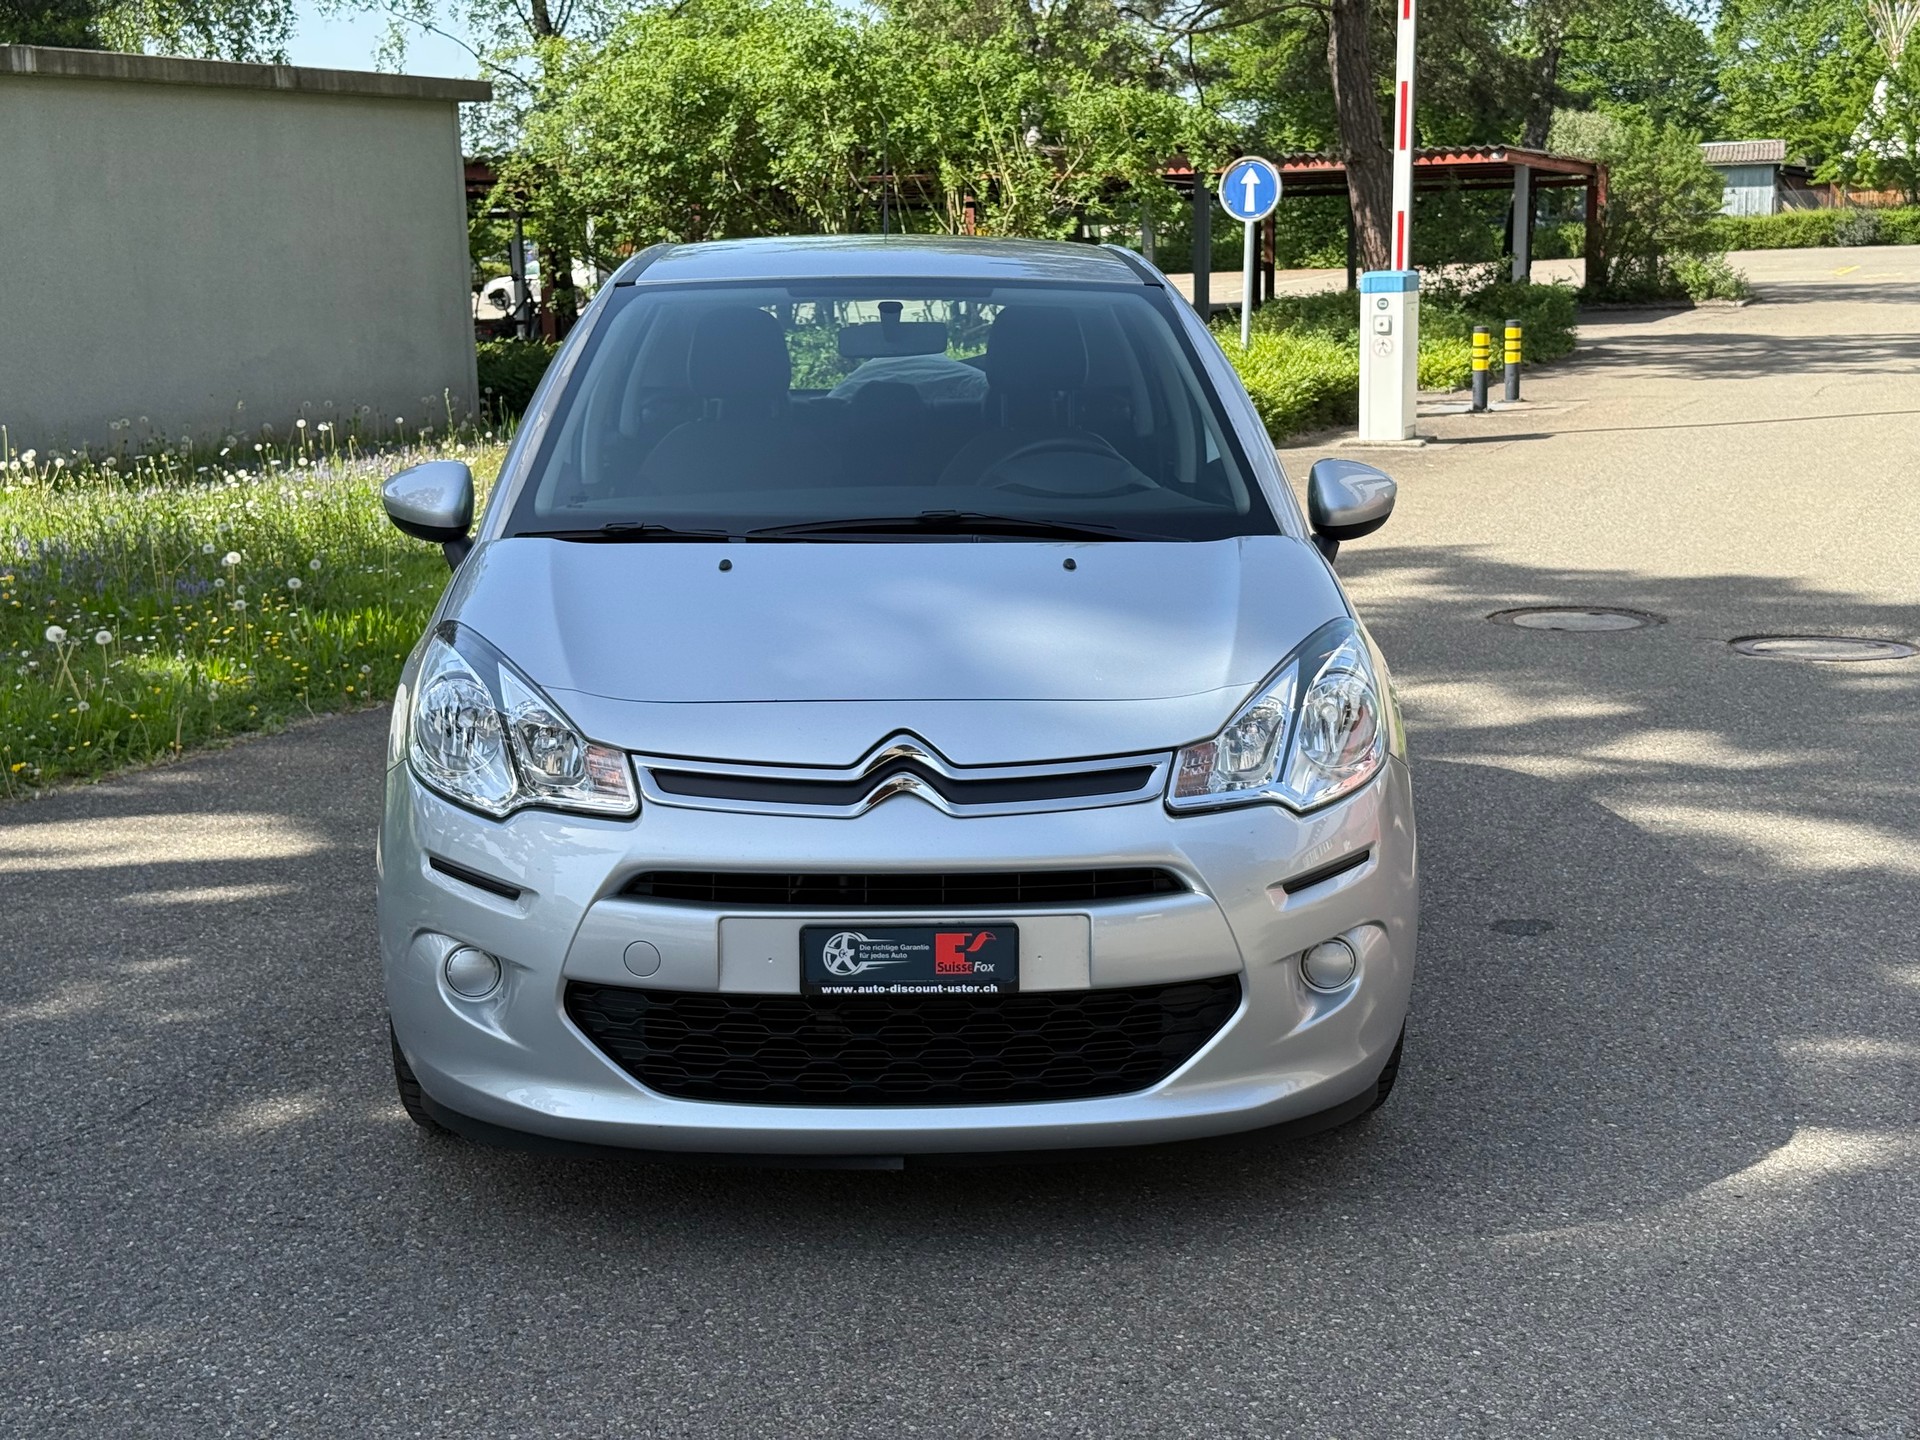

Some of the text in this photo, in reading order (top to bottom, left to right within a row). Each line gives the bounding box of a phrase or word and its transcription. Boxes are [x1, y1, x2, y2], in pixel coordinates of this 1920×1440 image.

[872, 944, 899, 952] richtige
[900, 943, 930, 951] Garantie
[870, 952, 889, 960] jedes
[821, 984, 998, 994] www.auto-discount-uster.ch
